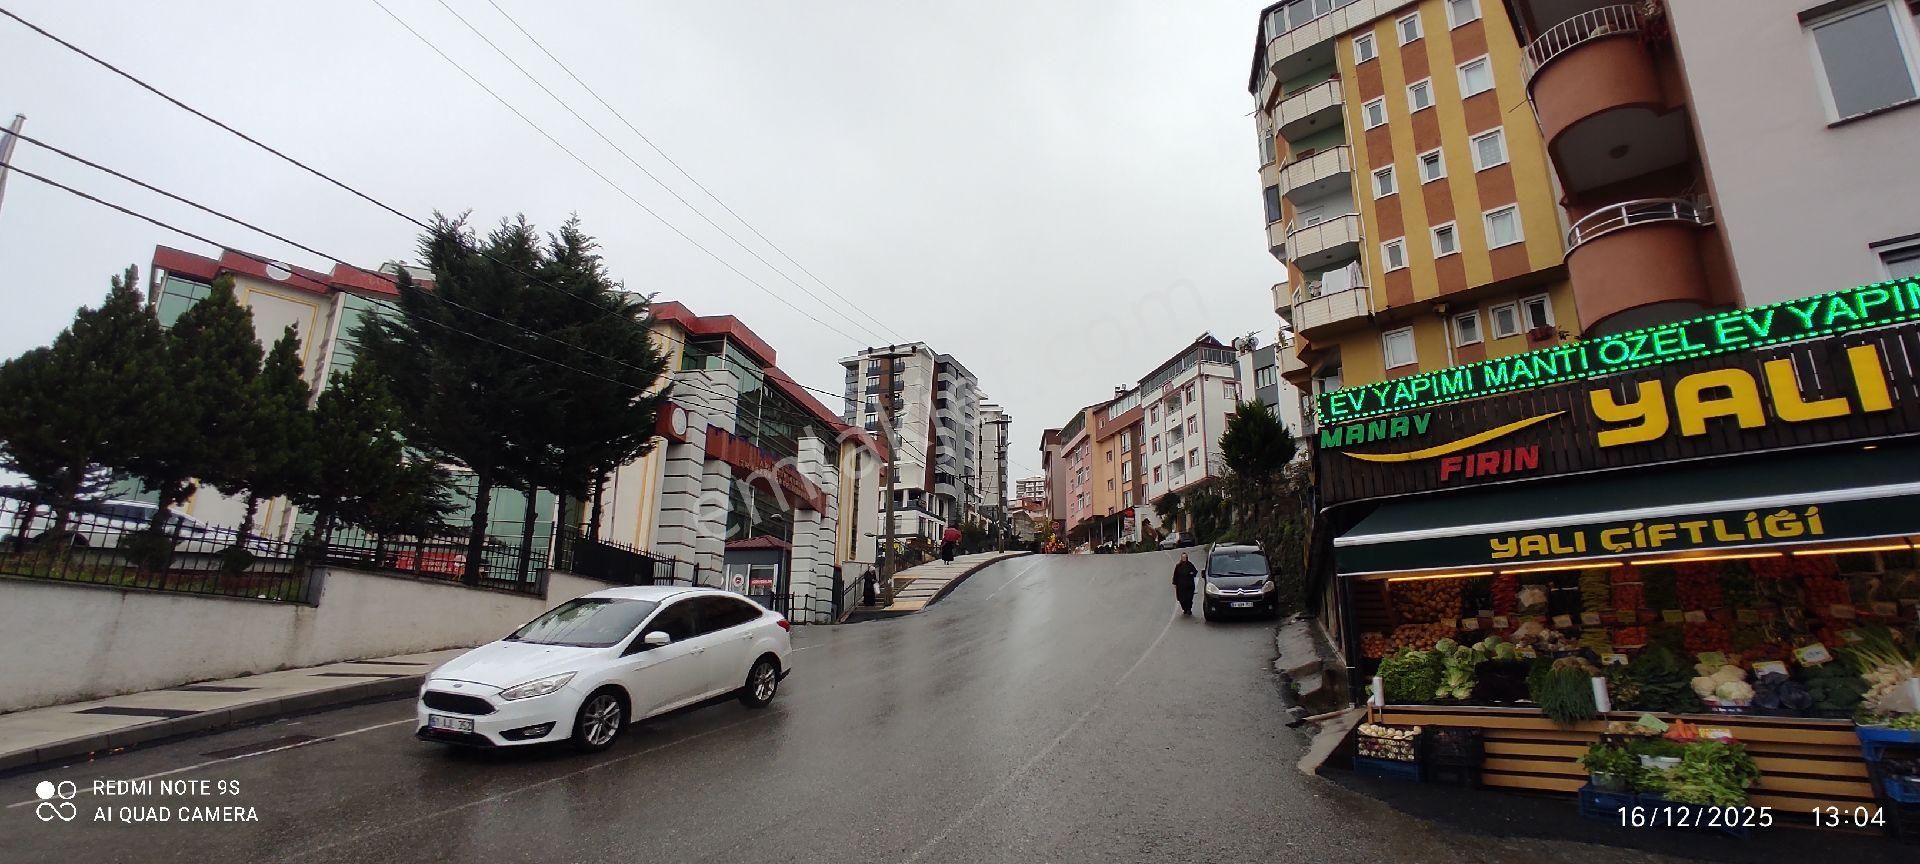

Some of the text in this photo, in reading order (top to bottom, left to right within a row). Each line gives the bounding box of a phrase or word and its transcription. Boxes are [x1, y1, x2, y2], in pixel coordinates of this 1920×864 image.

[1330, 391, 1366, 416] EV
[1371, 369, 1474, 406] YAPIMI
[1484, 347, 1588, 386] MANTI
[1715, 310, 1774, 345] EV
[1591, 345, 1892, 447] YALI
[1320, 412, 1431, 448] MANAV
[1440, 446, 1538, 481] FIRIN
[1490, 506, 1824, 559] YALI ÇİFTLİĞİ
